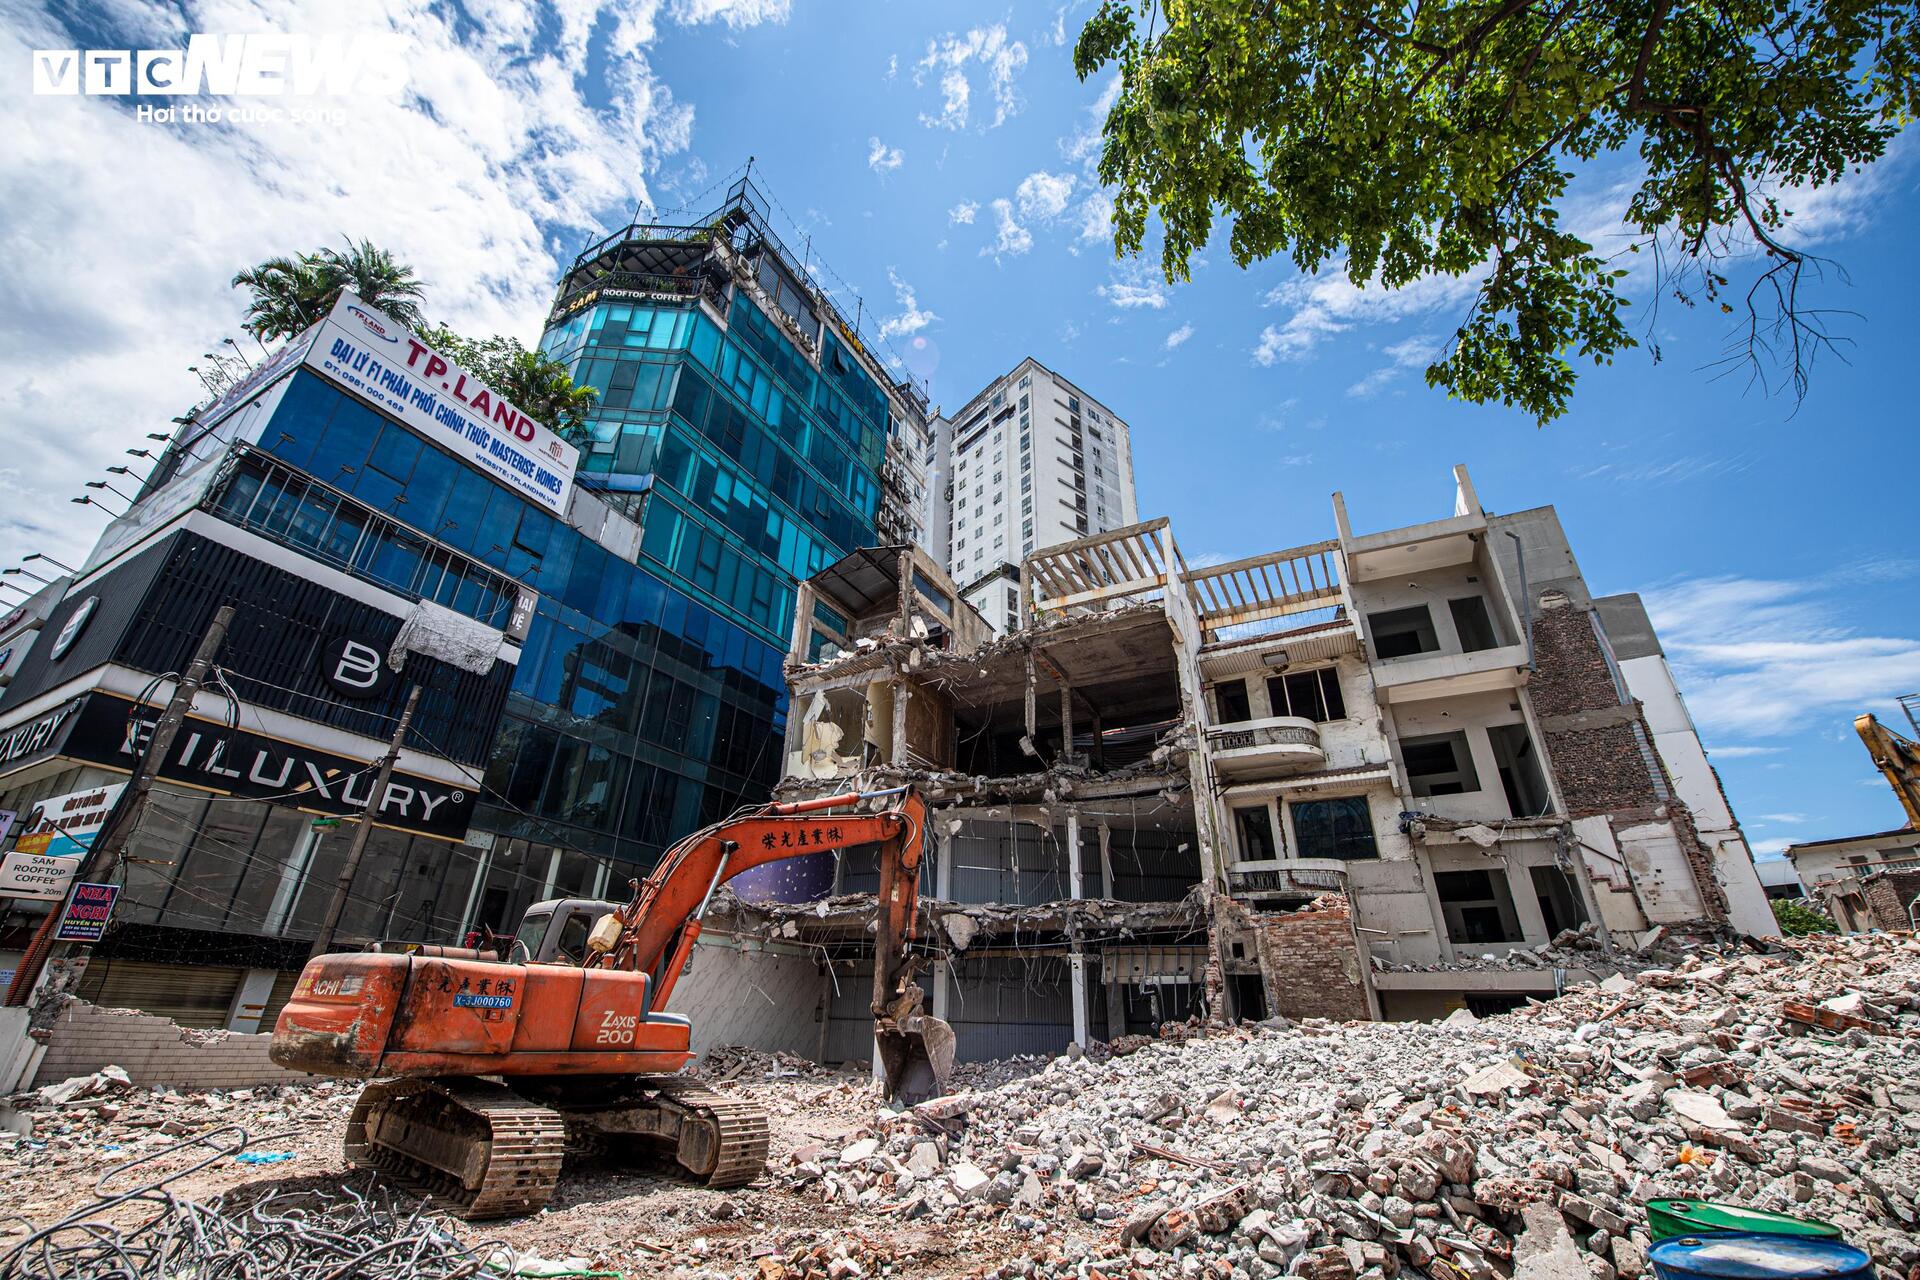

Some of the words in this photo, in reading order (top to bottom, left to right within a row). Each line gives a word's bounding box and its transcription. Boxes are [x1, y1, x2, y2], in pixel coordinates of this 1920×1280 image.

[569, 290, 598, 312] SAM
[602, 288, 646, 299] ROOFTOP
[651, 291, 684, 302] COFFEE
[354, 310, 386, 335] TP.LAND
[342, 371, 365, 389] 0981
[366, 386, 385, 401] 000
[407, 338, 536, 442] TP.LAND
[330, 337, 356, 363] ĐẠI
[352, 352, 370, 372] LÝ
[366, 360, 382, 382] F1
[380, 367, 413, 401] PHÂN
[410, 387, 437, 416] PHỐI
[435, 403, 466, 435] CHÍNH
[464, 422, 490, 449] THỨC
[488, 437, 537, 479] MASTERISE
[534, 466, 563, 496] HOMES
[517, 595, 533, 613] AI
[13, 864, 66, 876] ROOFTOP
[32, 856, 57, 866] SAM
[15, 874, 56, 885] COFFEE
[43, 888, 62, 896] 20m
[600, 1010, 637, 1029] ZAXIS
[596, 1029, 634, 1044] 200
